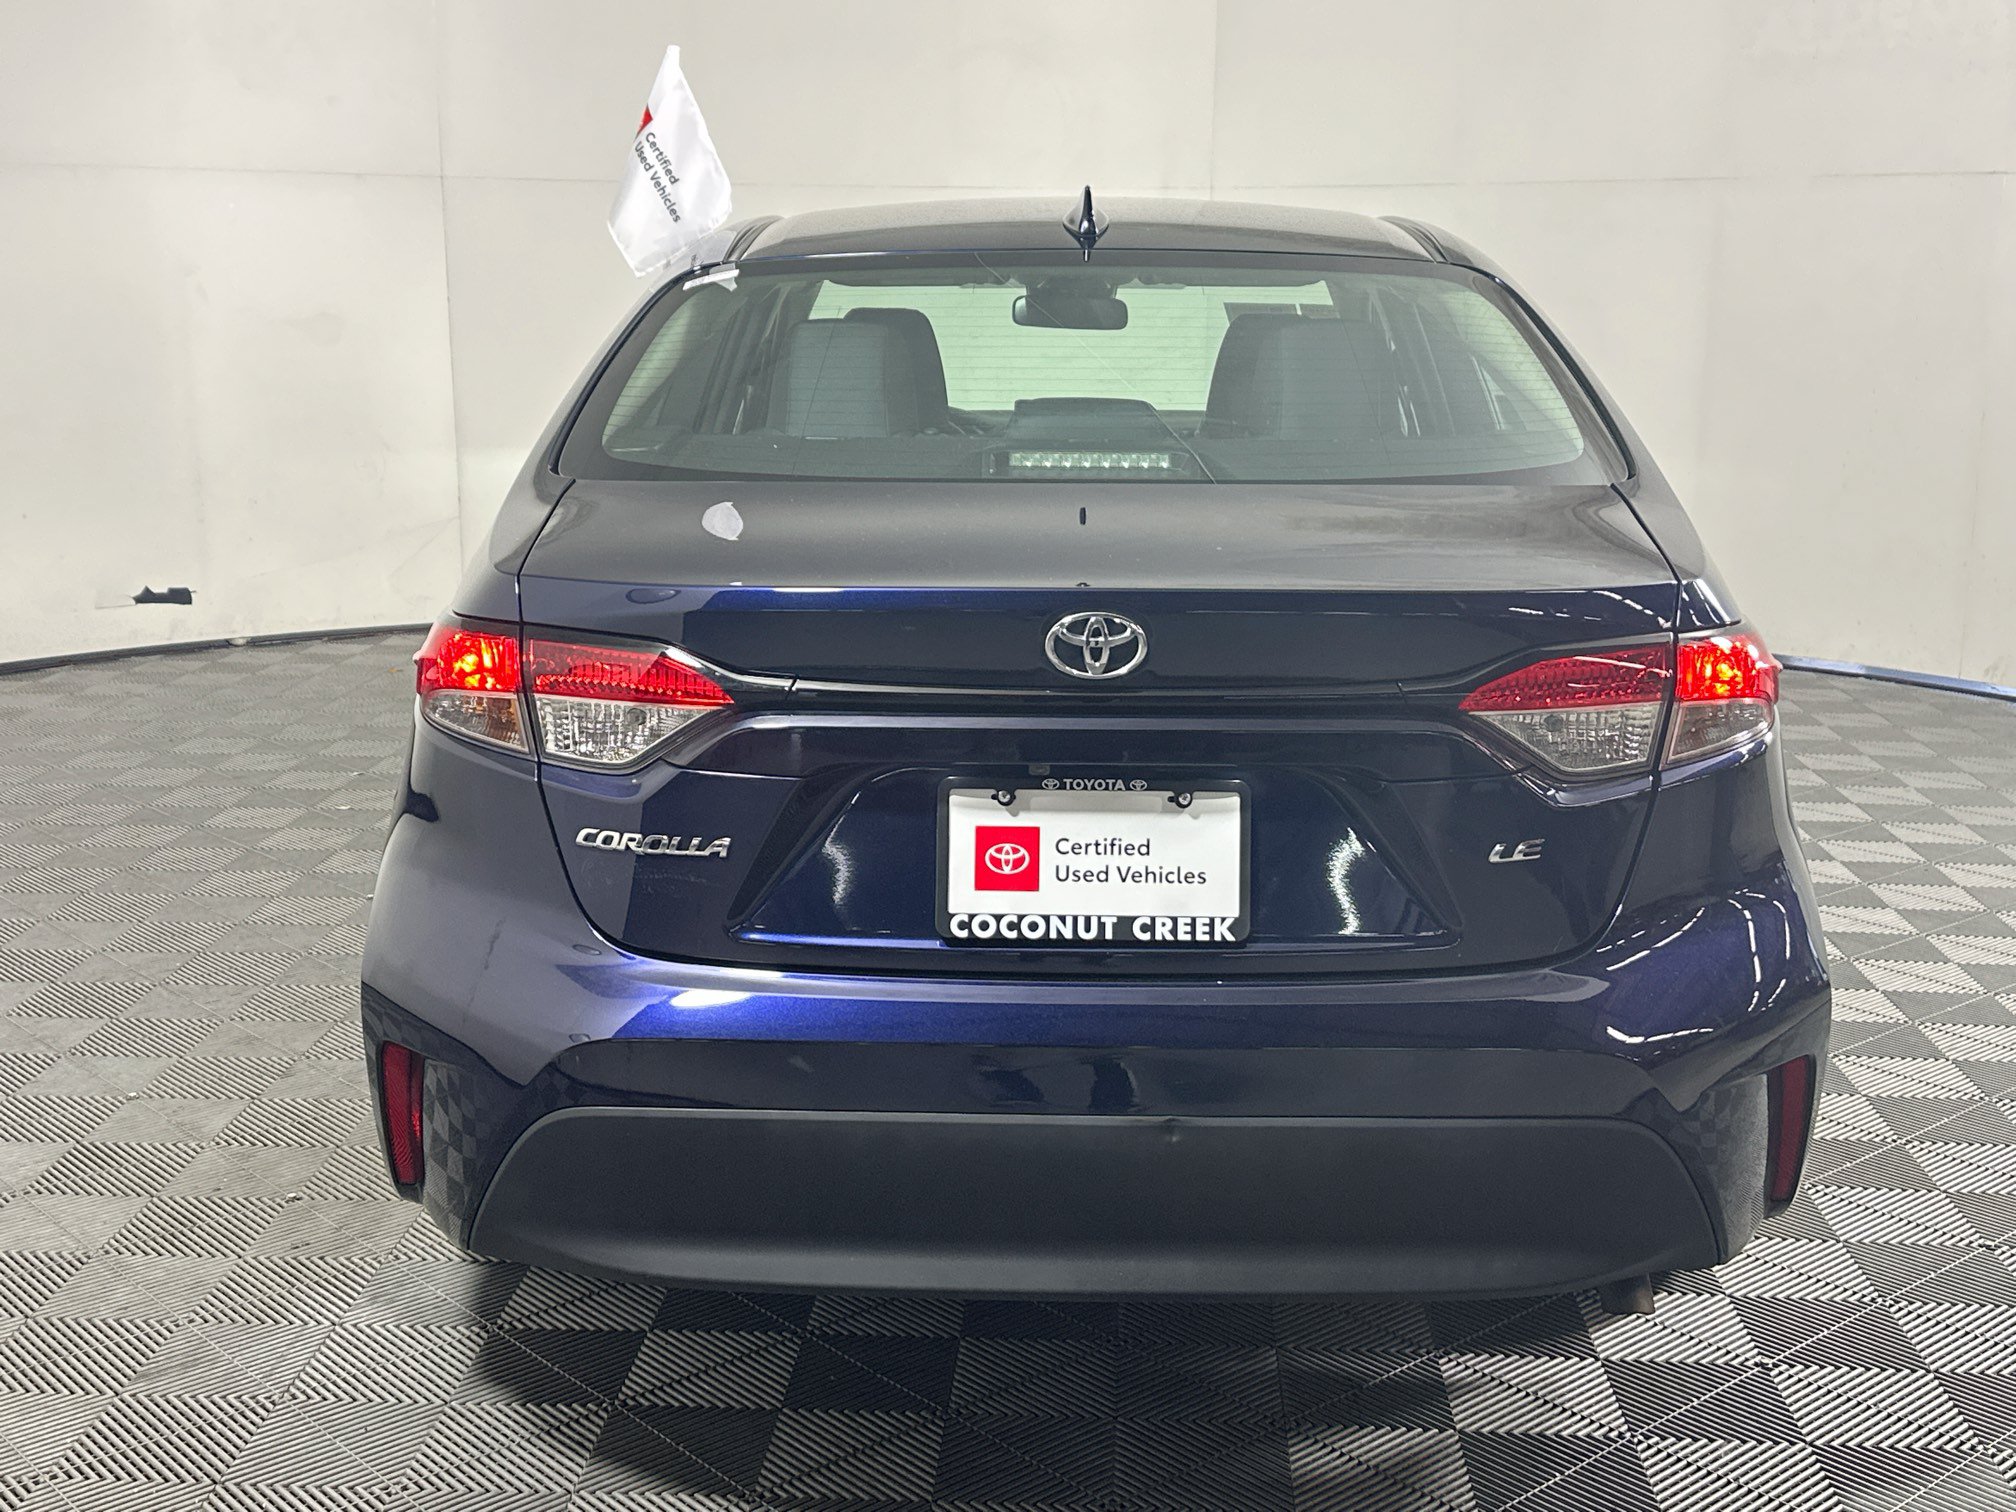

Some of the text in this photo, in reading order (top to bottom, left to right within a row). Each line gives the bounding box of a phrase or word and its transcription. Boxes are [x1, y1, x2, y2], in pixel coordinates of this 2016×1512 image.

[645, 132, 680, 185] Certified
[635, 141, 681, 223] Used Vehicles
[1063, 779, 1126, 791] TOYOTA
[575, 827, 731, 858] COROLLA
[1055, 838, 1151, 857] Certified
[1488, 839, 1545, 863] LE
[1055, 865, 1207, 885] Used Vehicles
[949, 913, 1236, 942] COCONUT CREEK
